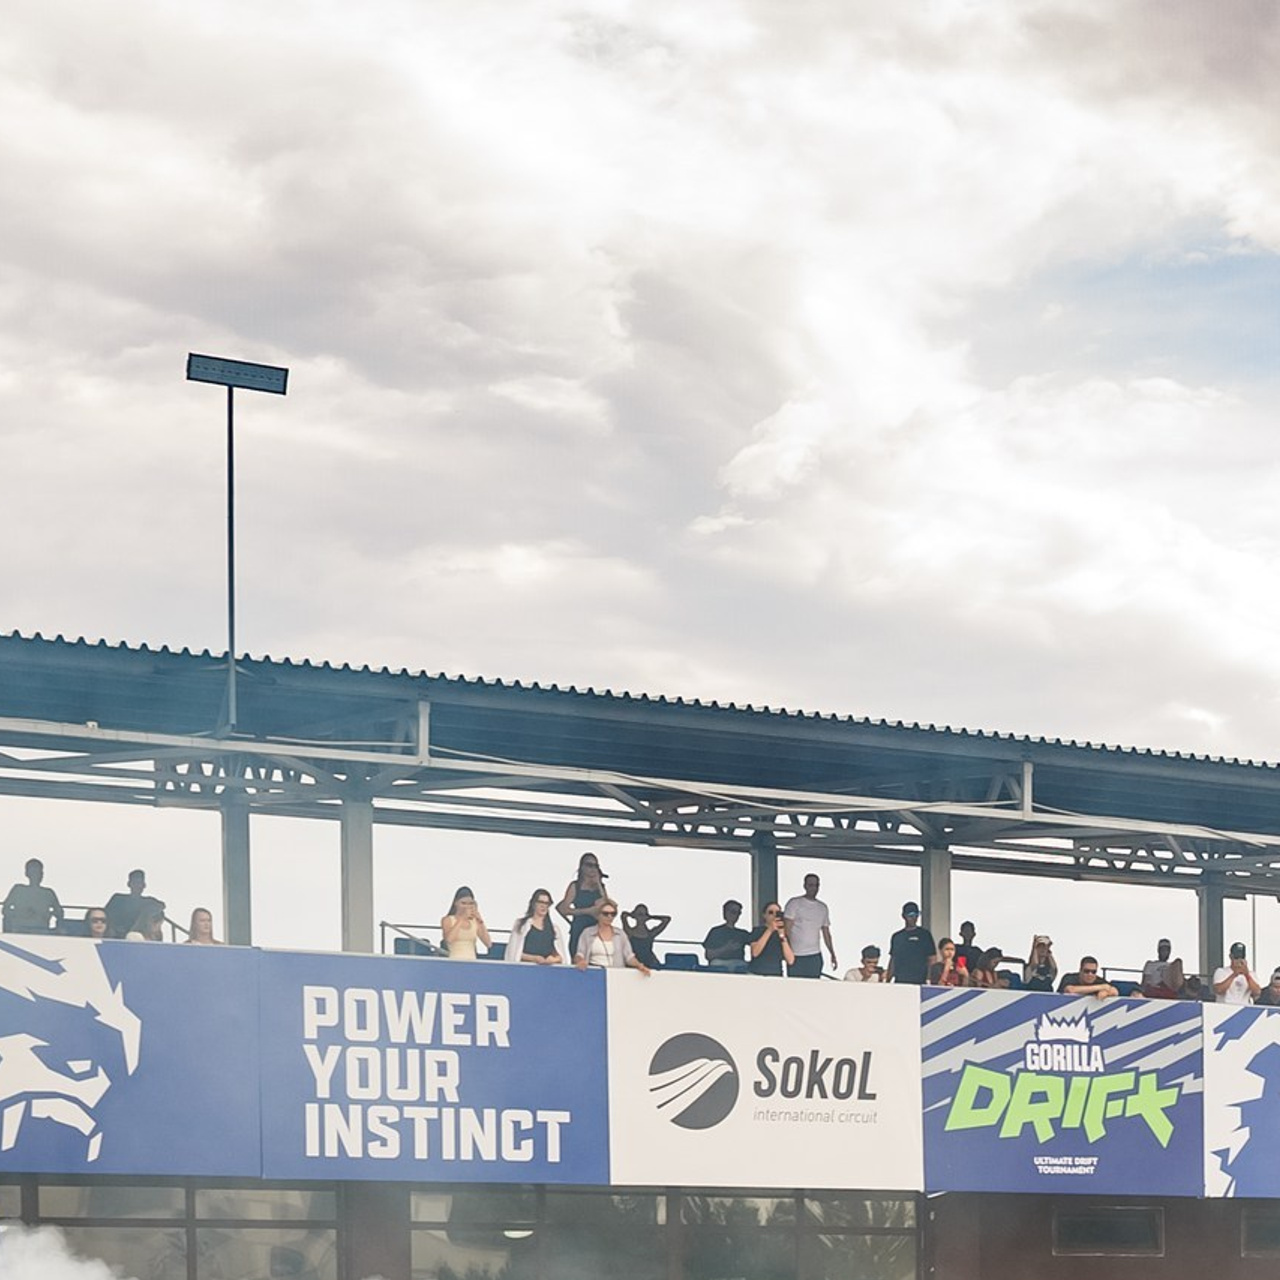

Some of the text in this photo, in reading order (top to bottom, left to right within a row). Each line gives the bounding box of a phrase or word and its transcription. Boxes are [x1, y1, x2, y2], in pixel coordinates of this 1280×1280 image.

[303, 985, 511, 1048] POWER
[1025, 1042, 1106, 1073] GORILLA
[303, 1044, 460, 1103] YOUR
[753, 1107, 878, 1125] international circuit
[304, 1103, 572, 1163] INSTINCT
[1034, 1156, 1099, 1167] ULTIMATE DRIFT
[1038, 1165, 1095, 1175] TOURNAMENT
